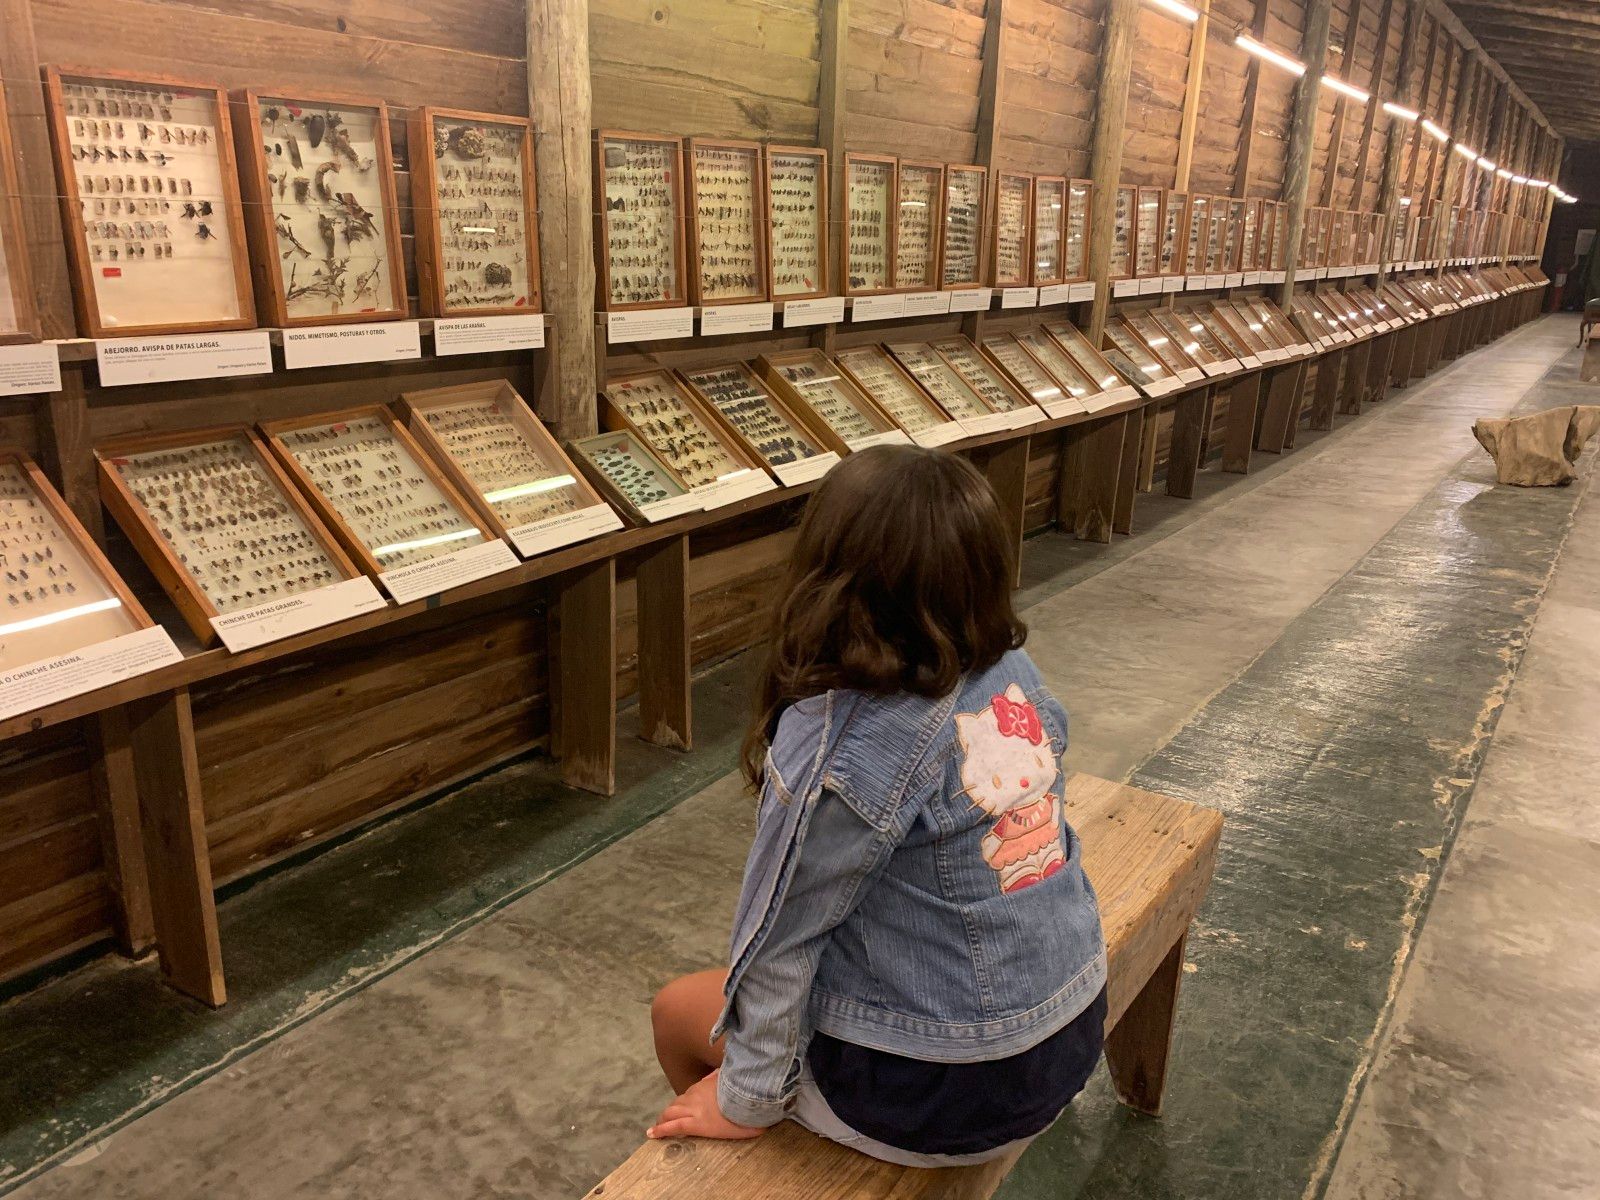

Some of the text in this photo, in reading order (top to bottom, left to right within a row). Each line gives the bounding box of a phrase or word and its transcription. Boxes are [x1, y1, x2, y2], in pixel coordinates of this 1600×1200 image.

[219, 614, 246, 627] CHINCHE
[256, 606, 275, 617] PATAS
[12, 665, 48, 681] CHINCHE
